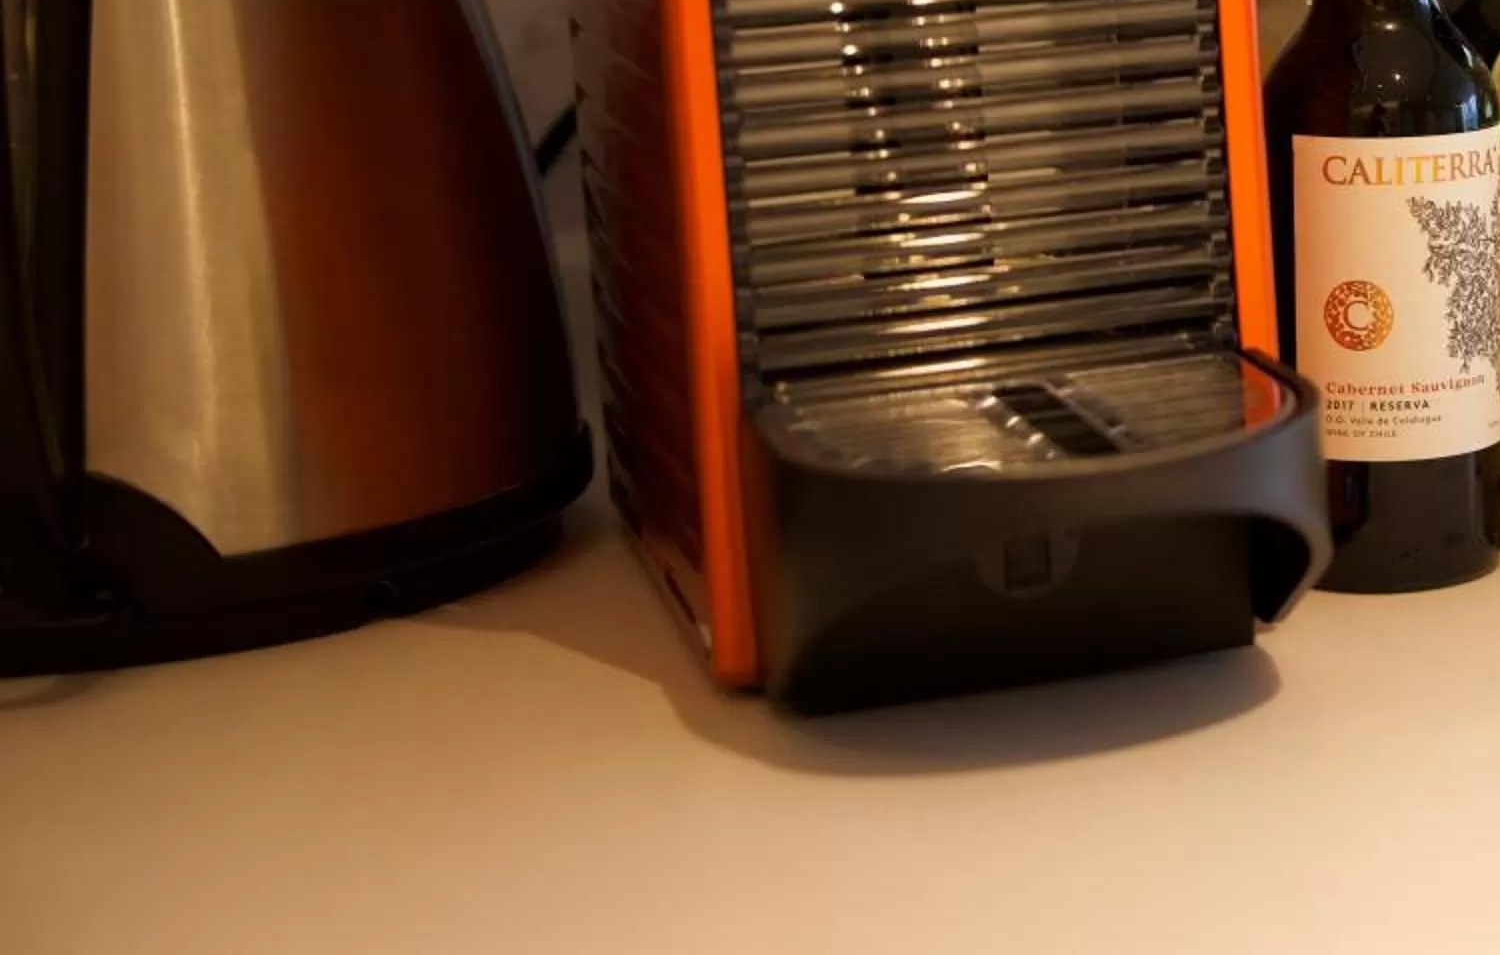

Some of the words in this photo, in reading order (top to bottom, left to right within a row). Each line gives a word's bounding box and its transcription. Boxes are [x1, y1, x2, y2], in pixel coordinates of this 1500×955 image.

[1322, 147, 1496, 186] CALITERRA
[1326, 380, 1405, 395] Cabernet
[1411, 374, 1485, 394] Sauvignon
[1326, 400, 1355, 411] 2017
[1369, 398, 1430, 411] RESERVA
